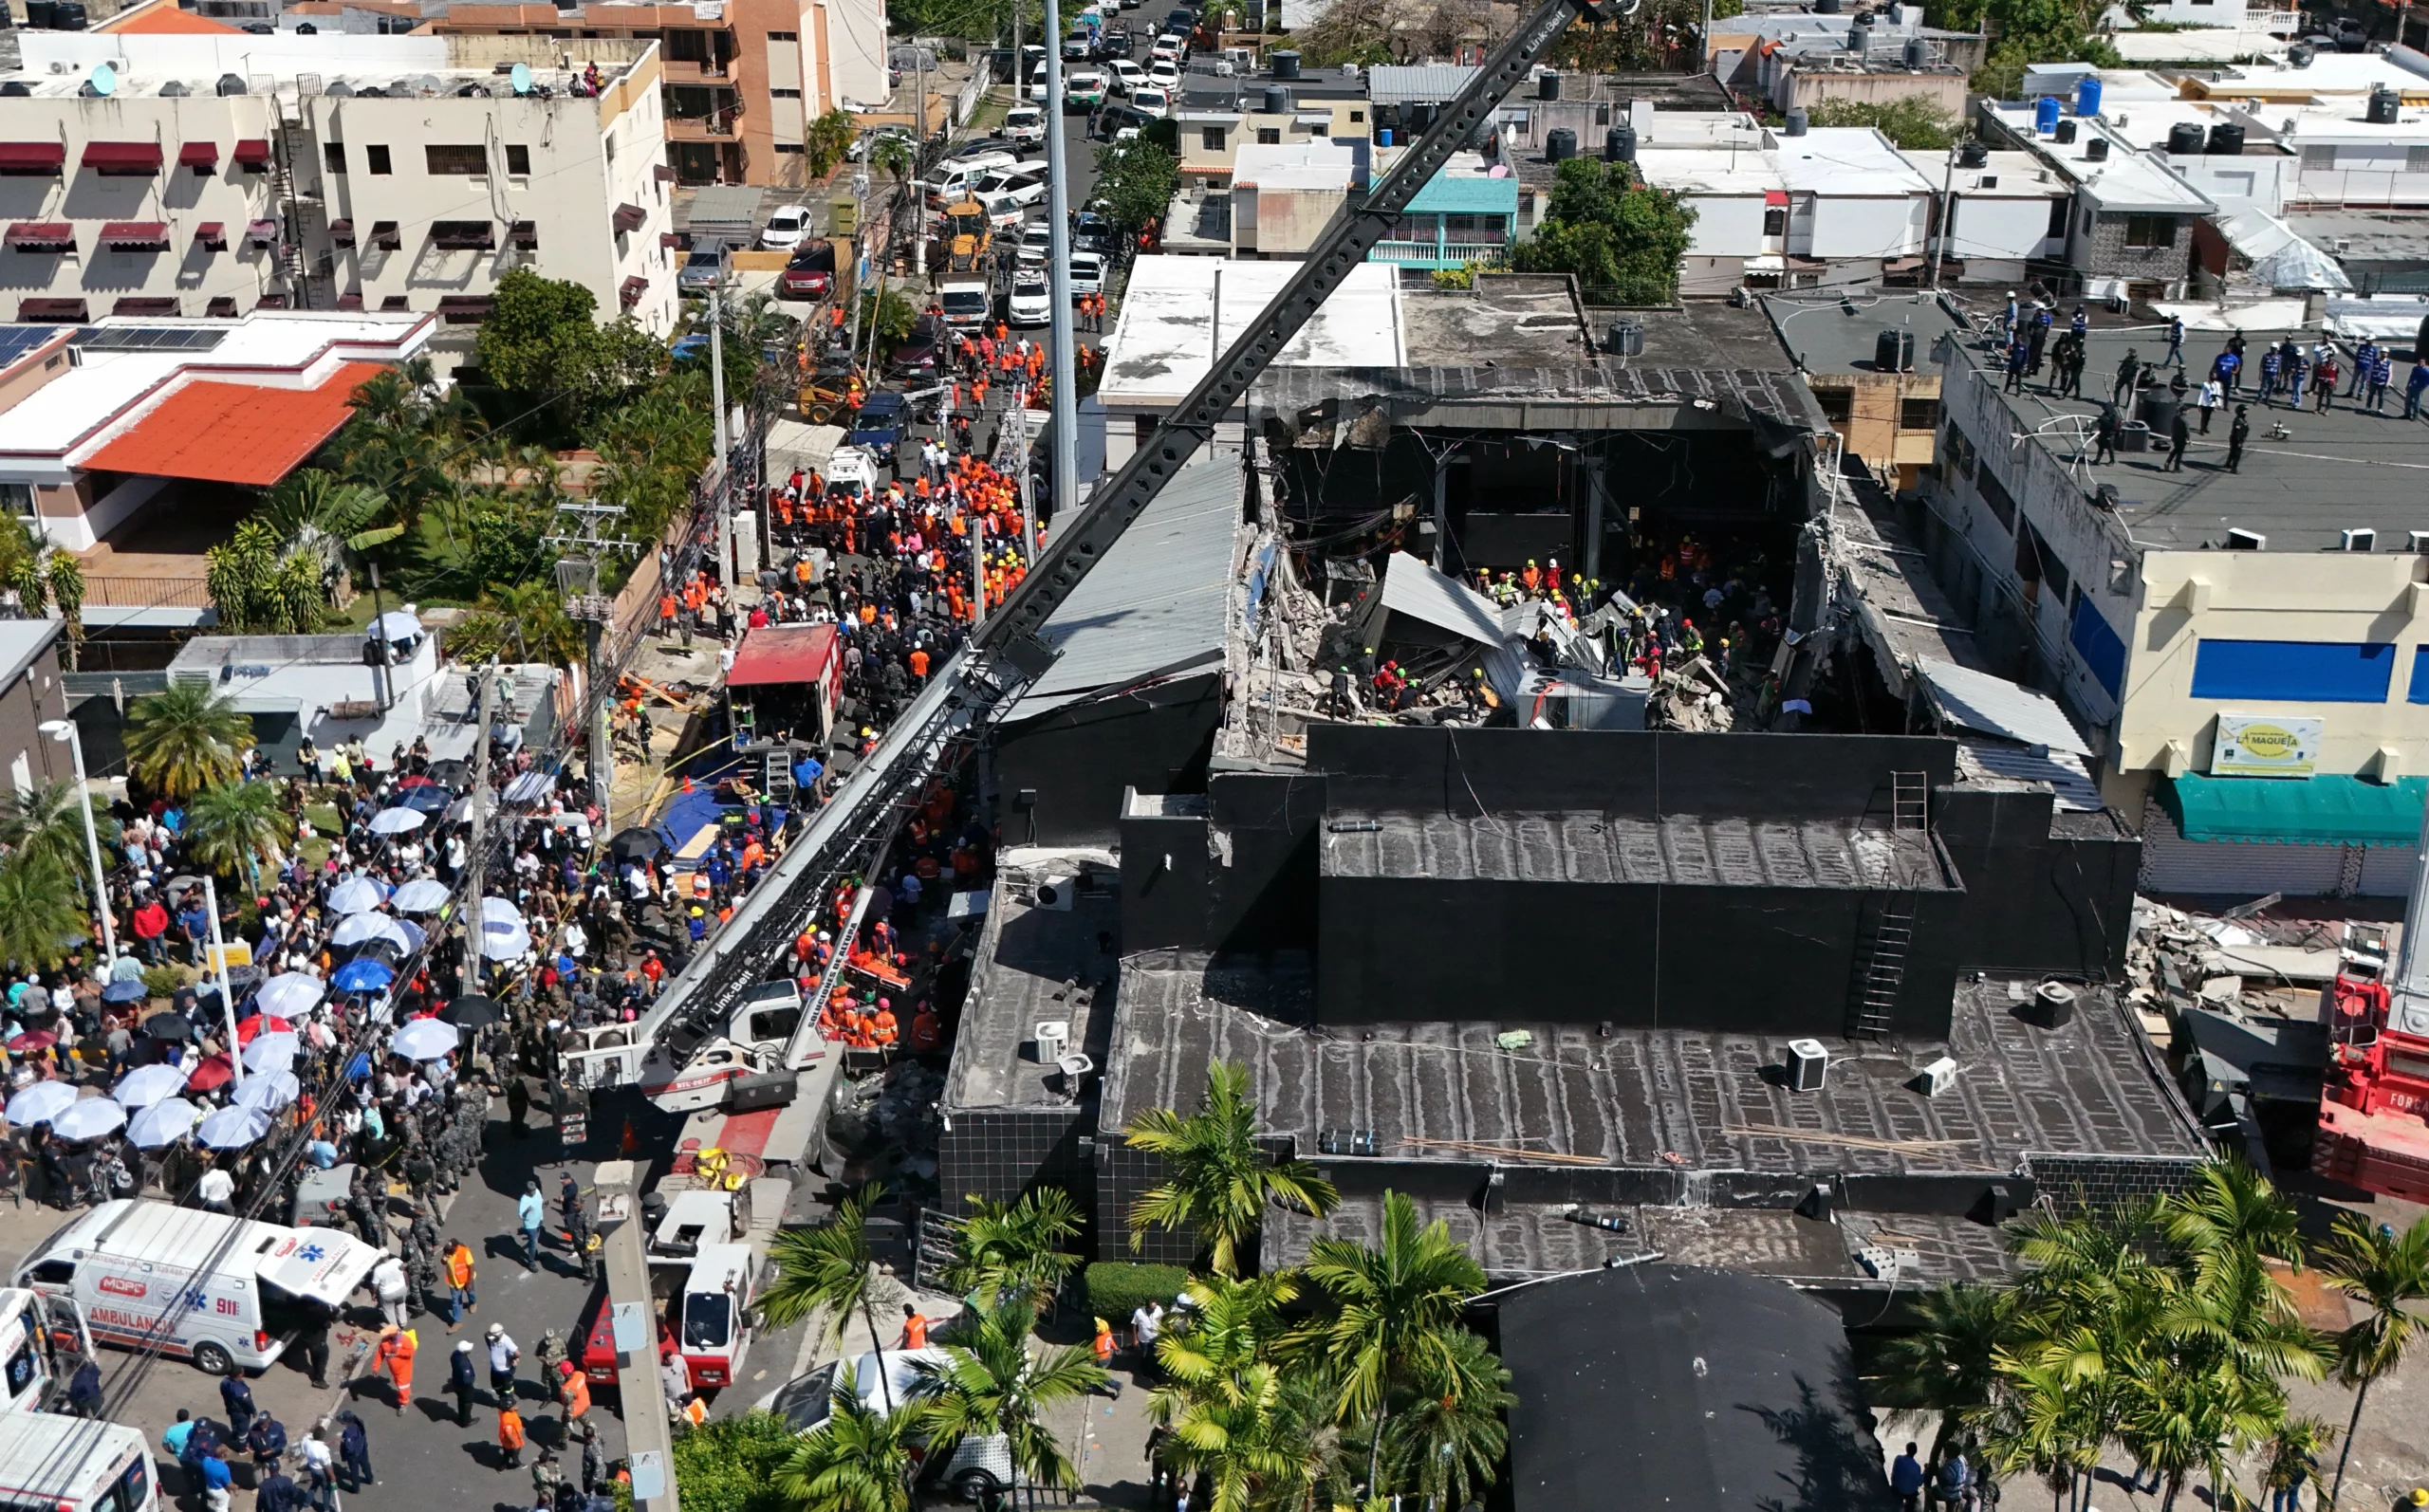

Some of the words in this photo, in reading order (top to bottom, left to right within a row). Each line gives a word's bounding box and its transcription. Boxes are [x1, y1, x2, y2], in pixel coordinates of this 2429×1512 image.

[1526, 9, 1566, 53] Link-Belt
[2235, 733, 2249, 746] LA
[2251, 735, 2298, 747] MAQUETA
[807, 970, 837, 1028] SOLUCIONES
[832, 956, 843, 969] DE
[839, 922, 858, 958] ALTURA
[710, 968, 754, 1015] Link-Belt
[84, 1253, 125, 1266] ASISTENCIA
[312, 1242, 349, 1282] AMBULANCIA
[103, 1278, 144, 1294] MOPC
[90, 1306, 176, 1336] AMBULANCIA
[216, 1298, 237, 1316] 911
